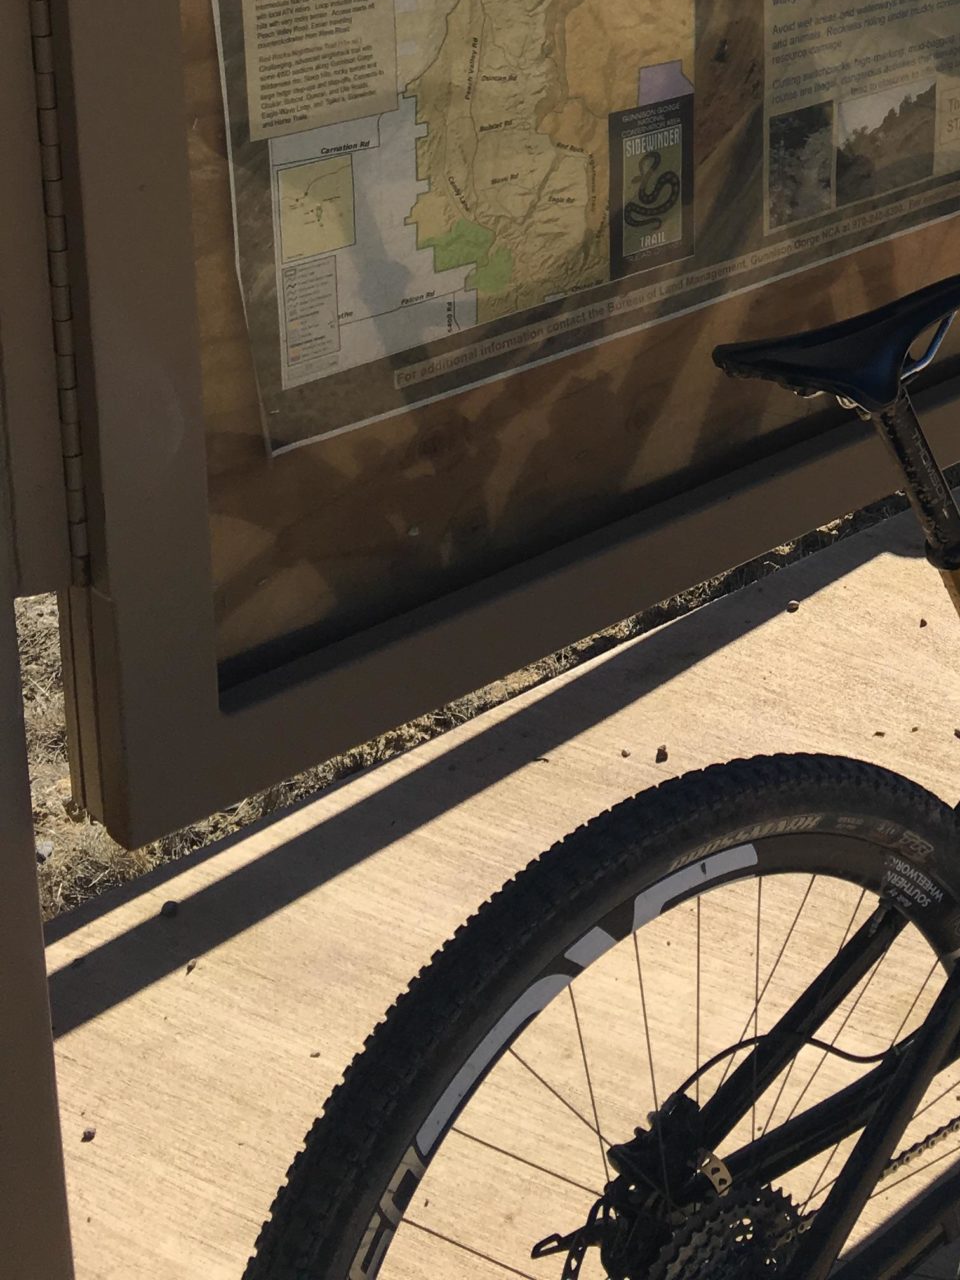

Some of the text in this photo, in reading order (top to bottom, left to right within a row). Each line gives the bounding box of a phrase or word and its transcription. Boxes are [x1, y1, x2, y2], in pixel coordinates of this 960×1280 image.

[320, 140, 370, 155] Carnation Rd
[626, 129, 680, 158] SIDEWINDER
[640, 231, 667, 249] TRAIL
[395, 367, 416, 385] For
[419, 346, 478, 377] additional
[478, 324, 543, 357] information
[545, 310, 586, 334] contact
[587, 303, 606, 320] the
[607, 291, 643, 313] Bureau
[646, 286, 657, 300] of
[658, 277, 683, 295] Land
[793, 231, 820, 250] Gorge
[820, 224, 840, 240] NCA
[887, 870, 932, 908] SOUTHERN
